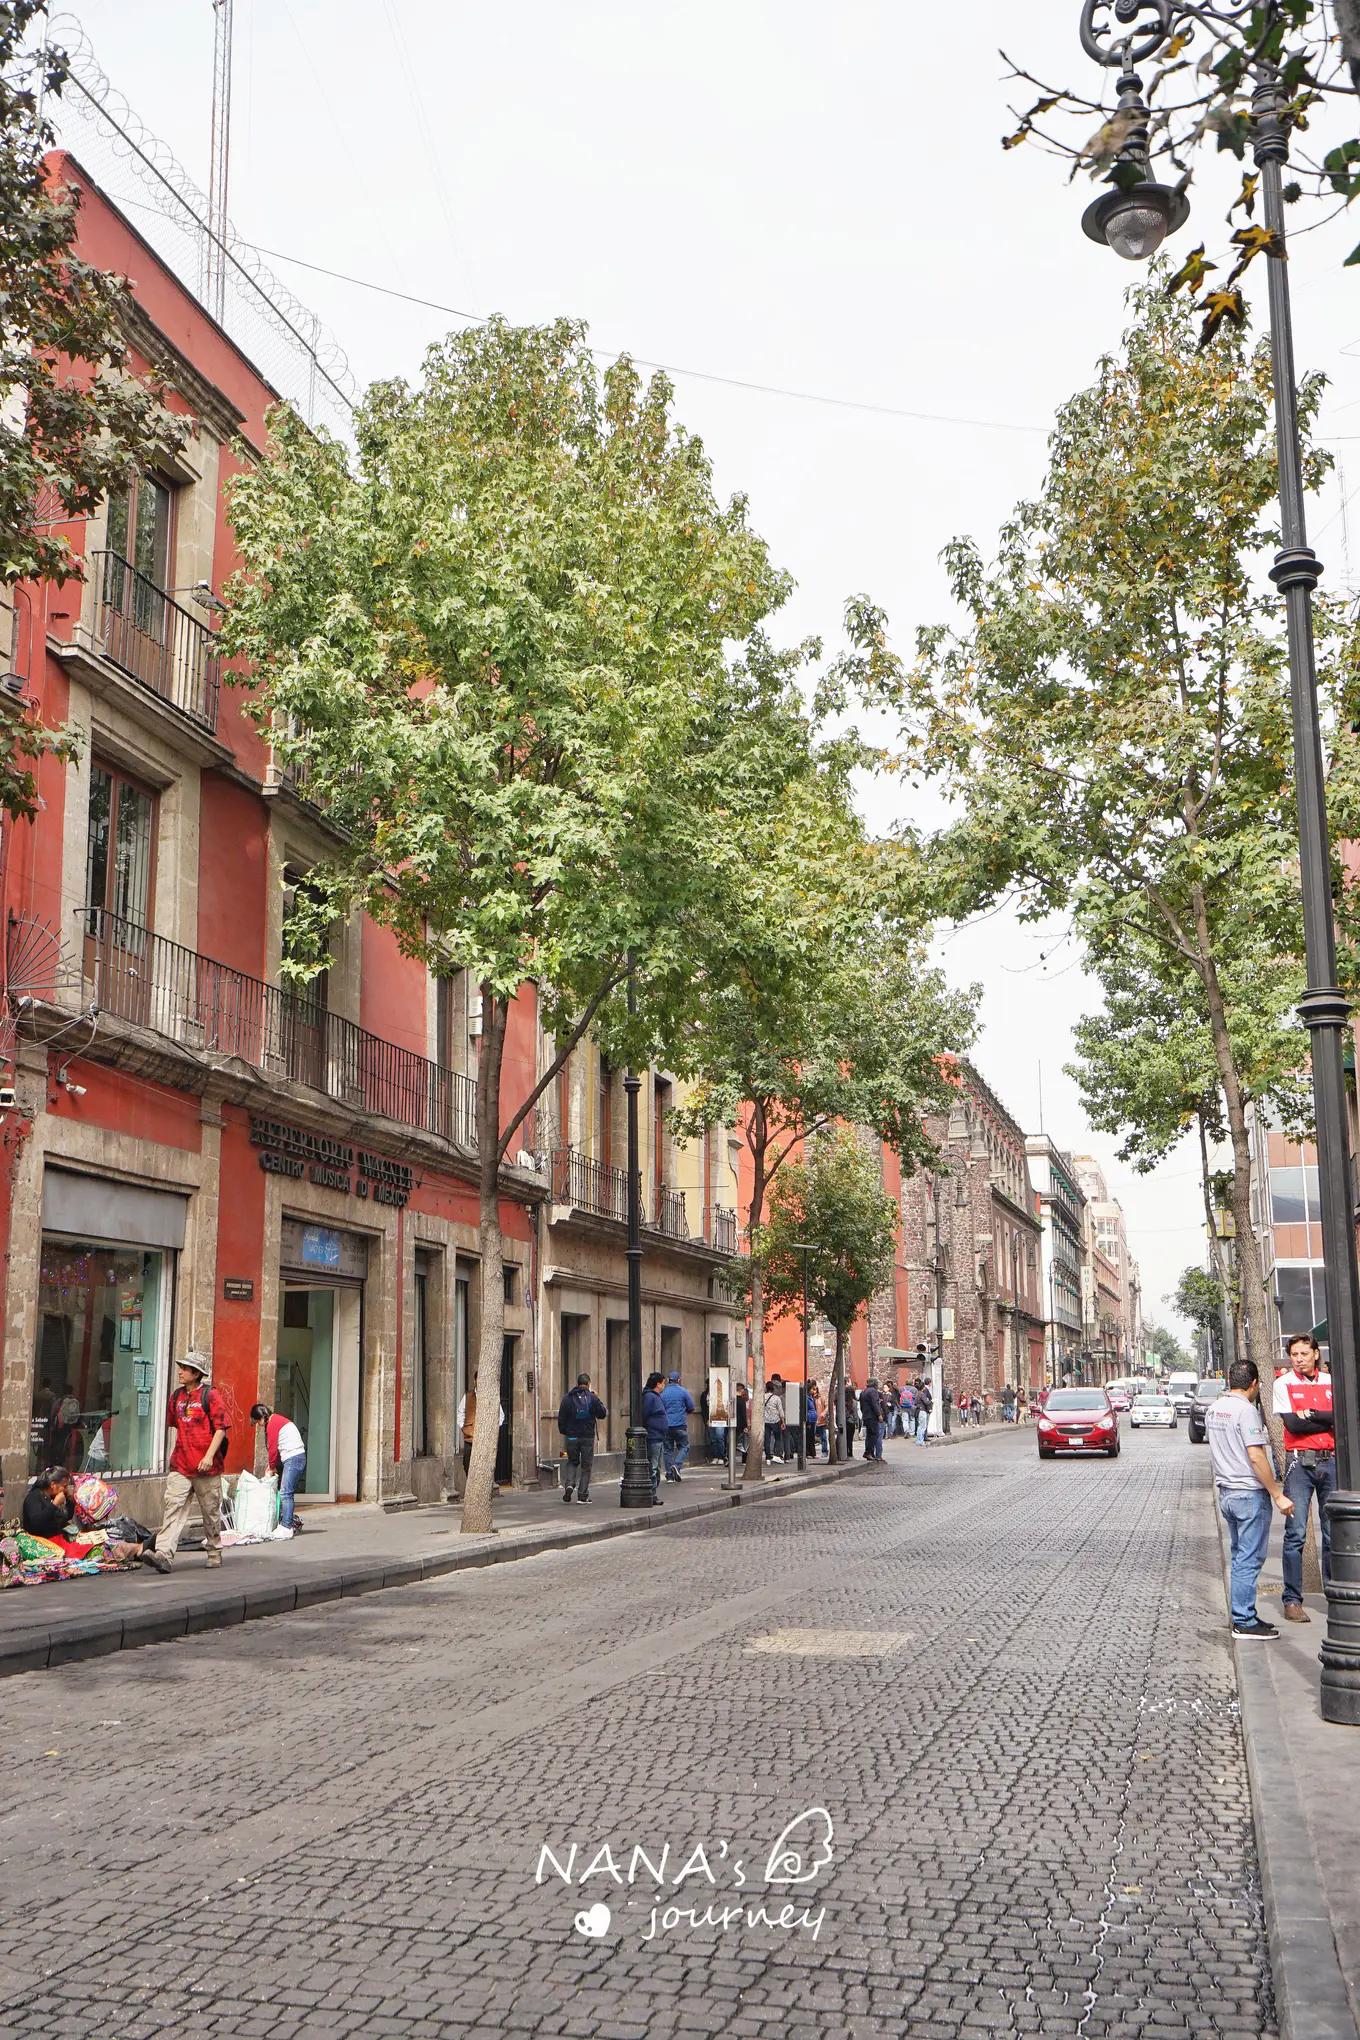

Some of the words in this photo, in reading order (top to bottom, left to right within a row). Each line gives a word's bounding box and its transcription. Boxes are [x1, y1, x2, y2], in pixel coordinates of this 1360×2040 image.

[251, 1119, 353, 1170] REPERTORIO
[360, 1151, 411, 1189] WAGNER
[260, 1151, 304, 1178] CENTRO
[375, 1184, 409, 1206] MEXICO
